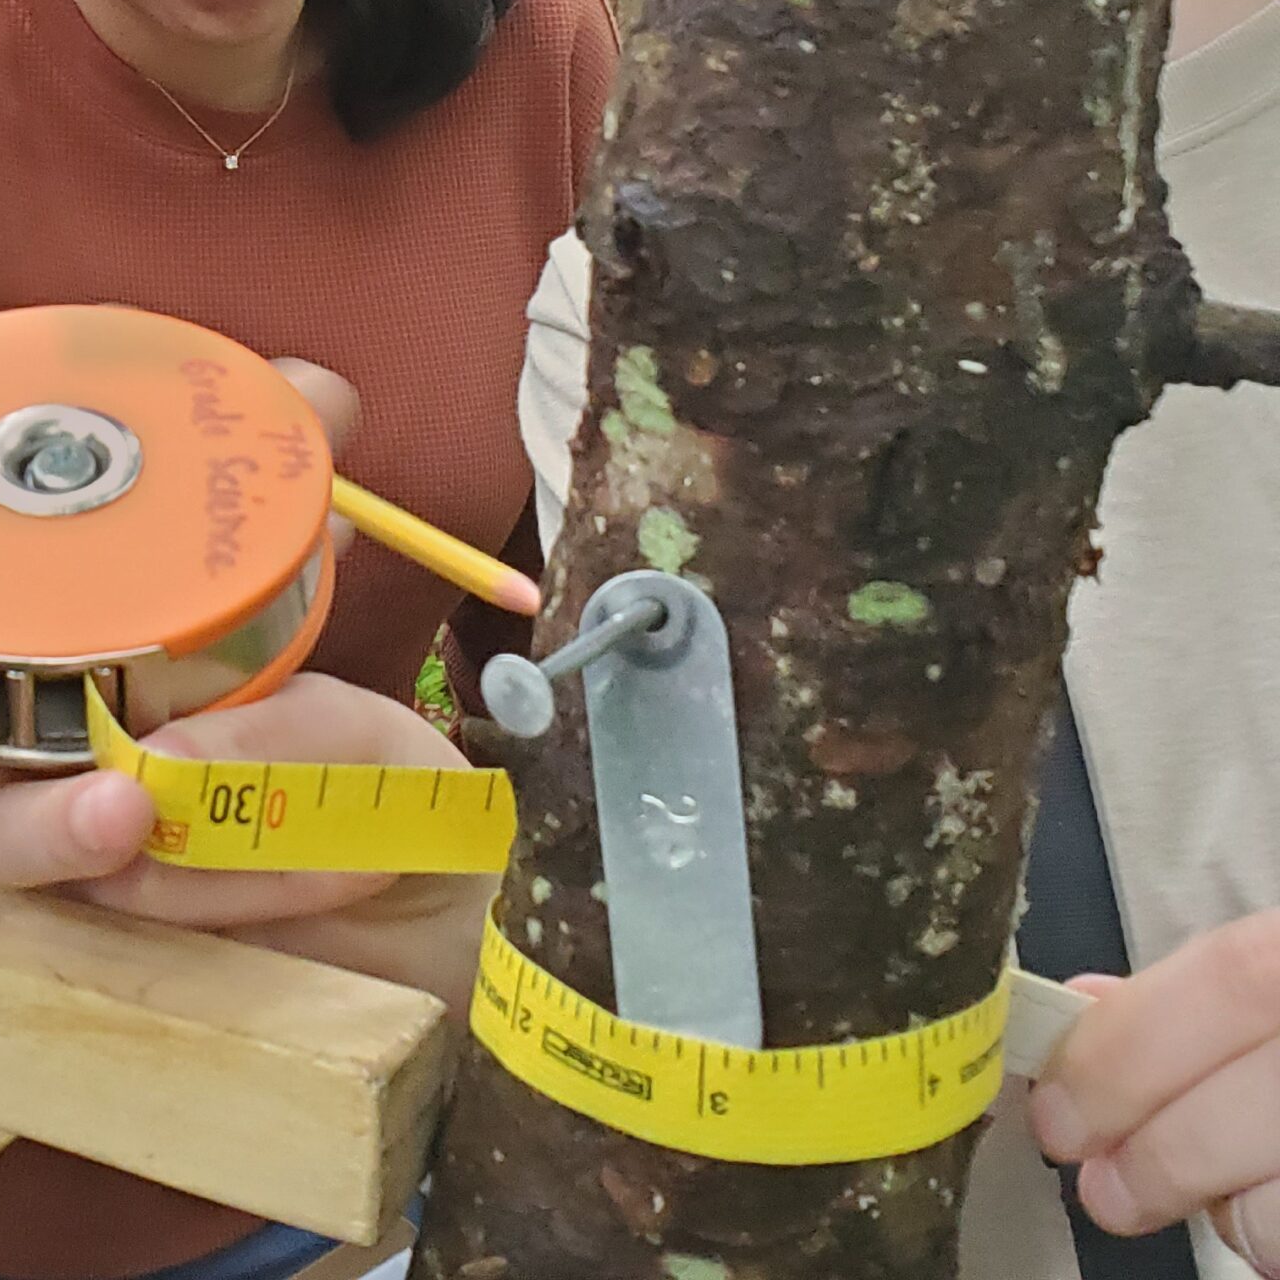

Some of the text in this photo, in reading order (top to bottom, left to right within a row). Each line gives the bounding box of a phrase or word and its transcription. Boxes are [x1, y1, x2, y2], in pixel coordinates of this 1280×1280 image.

[179, 358, 245, 437] Grade
[209, 784, 256, 825] 30
[266, 787, 287, 829] 0
[519, 1006, 532, 1033] 2
[927, 1073, 941, 1097] 4
[710, 1091, 728, 1116] 3
